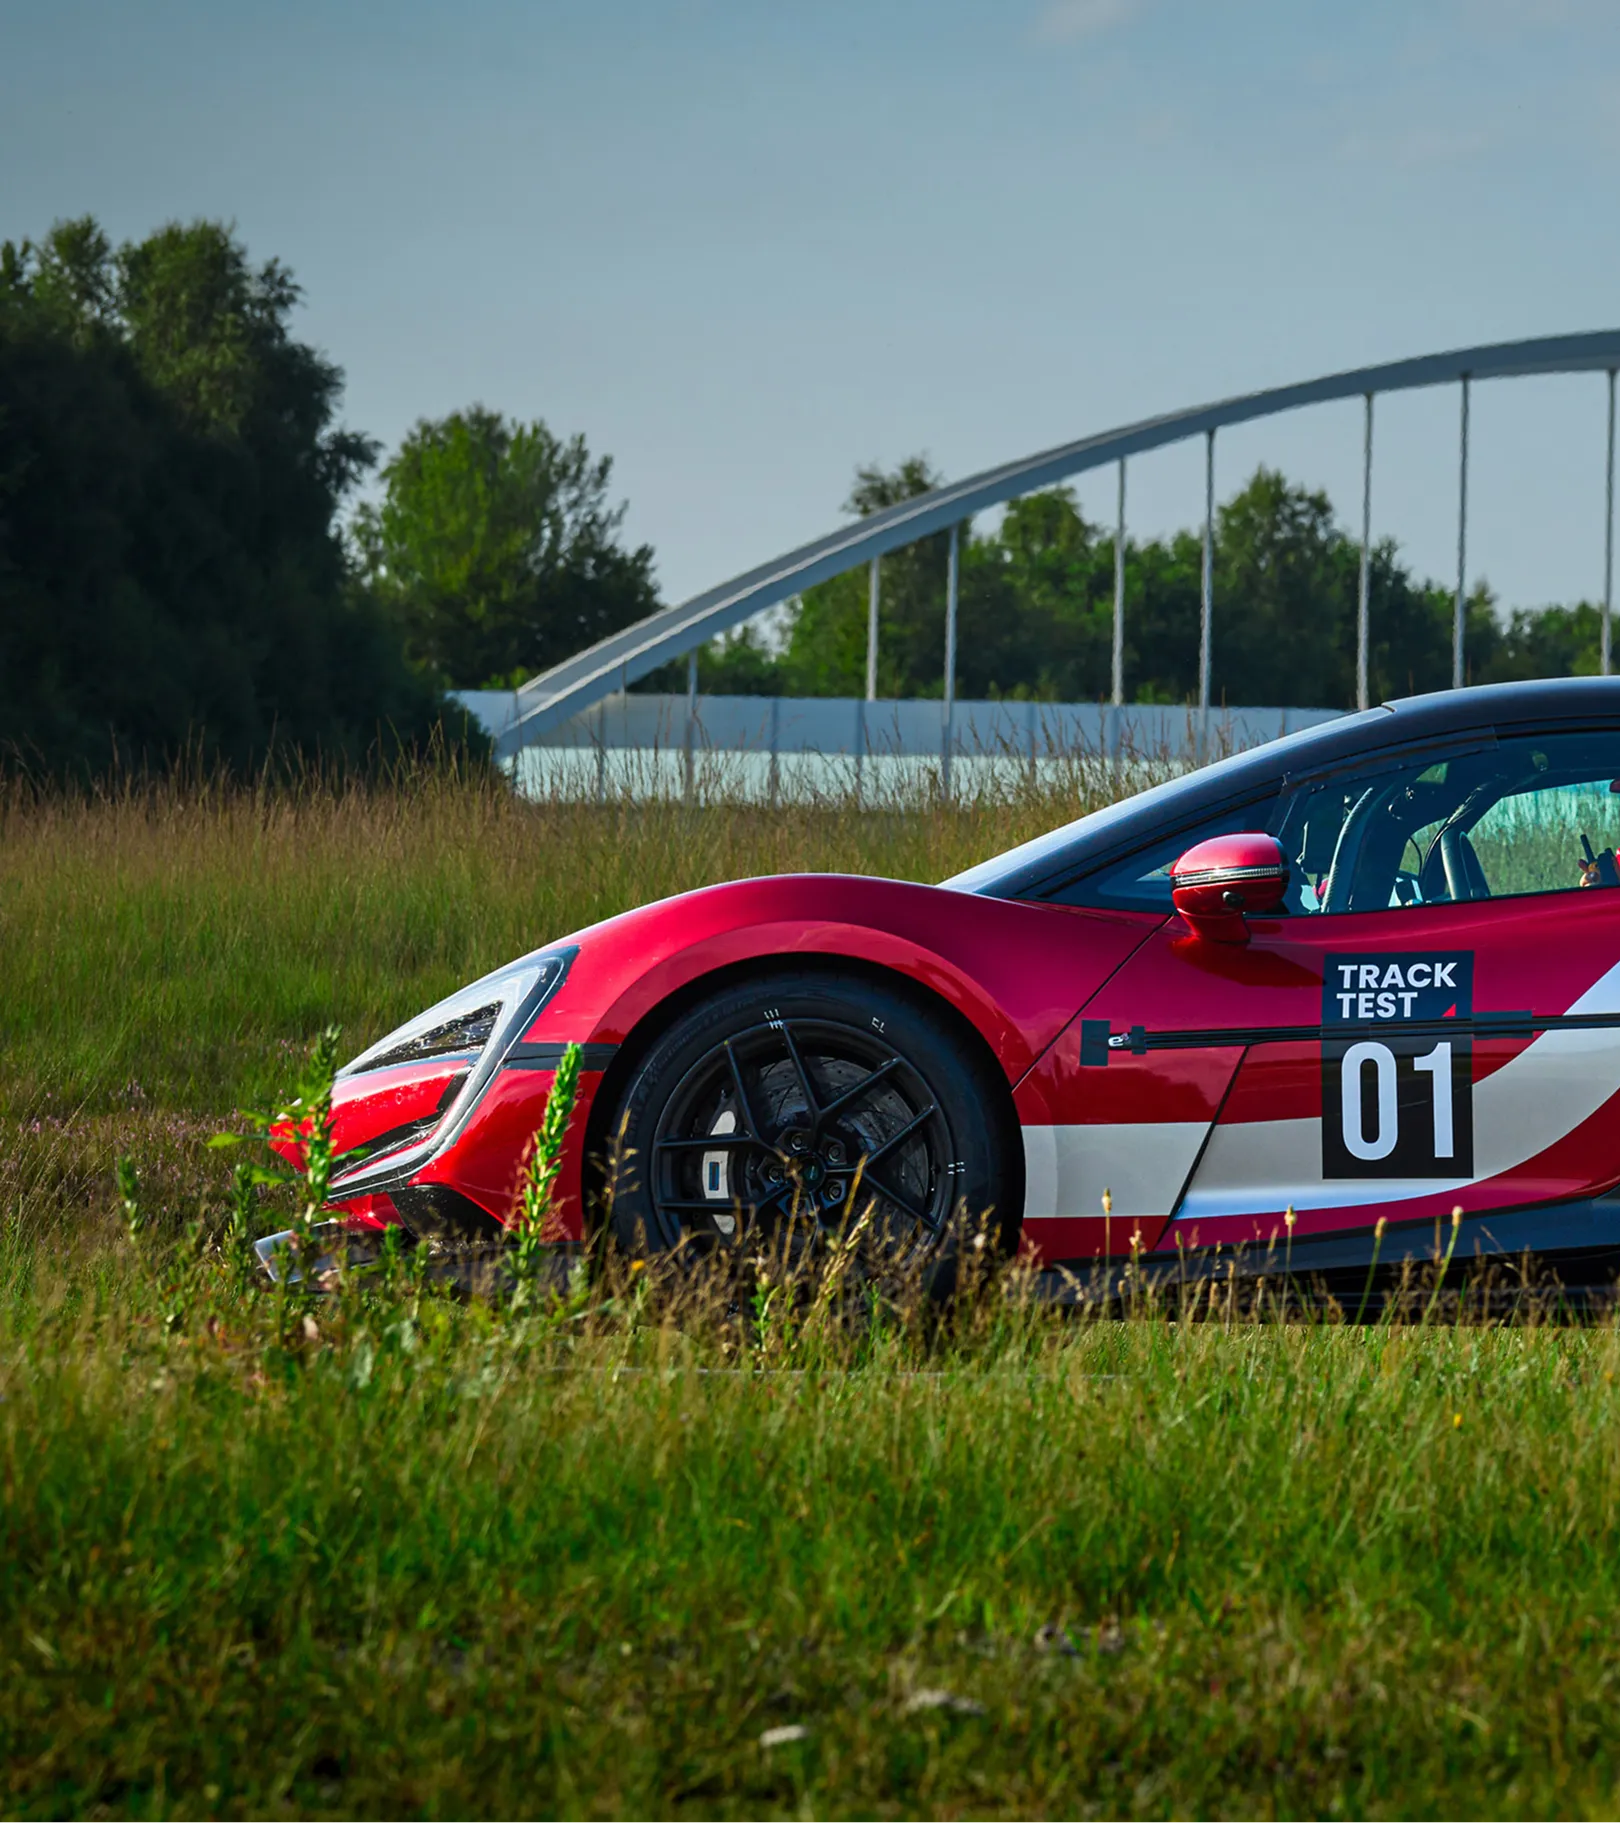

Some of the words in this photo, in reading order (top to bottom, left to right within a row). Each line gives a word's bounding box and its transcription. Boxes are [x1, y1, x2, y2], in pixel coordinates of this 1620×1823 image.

[1338, 962, 1458, 989] TRACK
[1336, 992, 1418, 1019] TEST
[1341, 1041, 1455, 1161] 01
